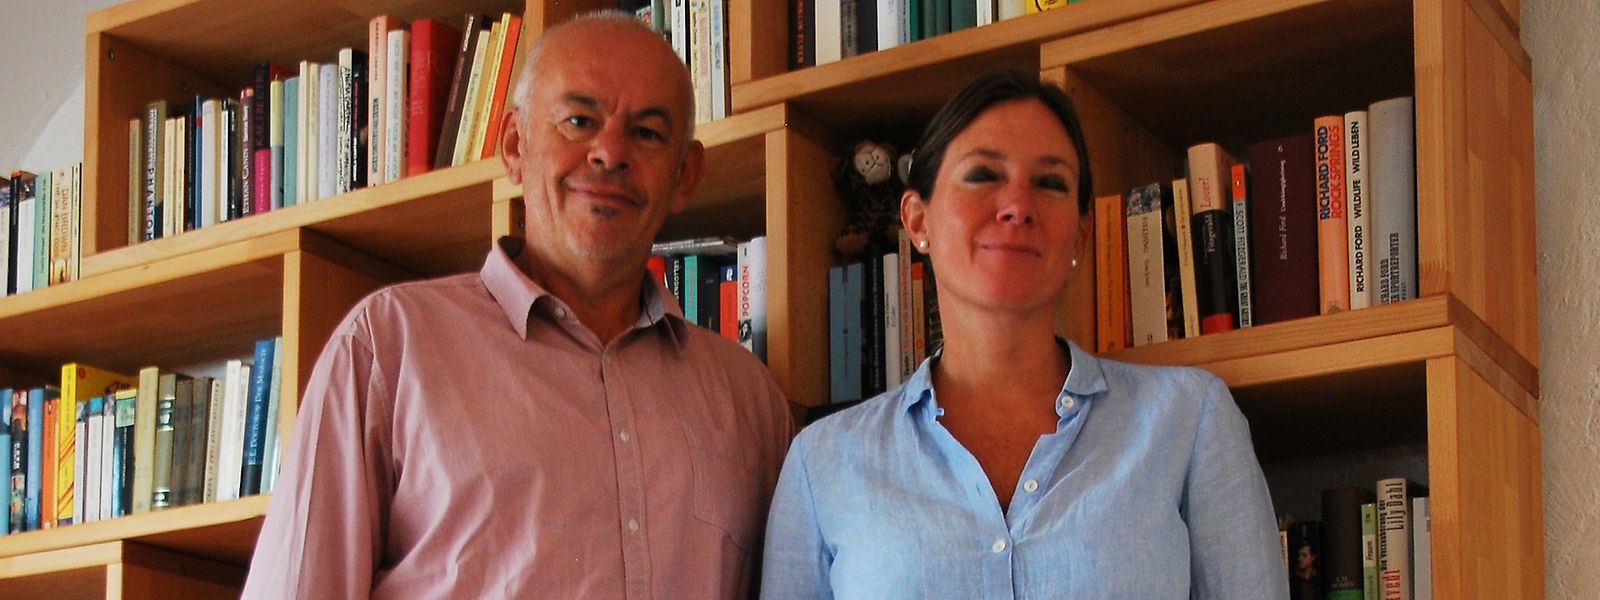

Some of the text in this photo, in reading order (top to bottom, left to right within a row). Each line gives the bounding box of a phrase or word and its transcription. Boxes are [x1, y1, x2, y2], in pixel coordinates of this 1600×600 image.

[1198, 177, 1211, 208] Lover!
[1317, 126, 1331, 220] RICHARD FORD
[1328, 125, 1343, 219] ROCK SPRINGS
[146, 167, 155, 241] PHANTOM
[242, 180, 250, 214] ETHAN
[1350, 121, 1365, 292] RICHARD FORD WILDLIFE WILD LEBEN
[60, 213, 69, 252] BROWN
[1142, 216, 1150, 254] FIELDING
[1204, 214, 1216, 253] Fitzgerald
[1236, 211, 1245, 233] SCOTT
[1278, 216, 1287, 232] Ford
[1236, 237, 1247, 280] FITZGERALD
[1279, 234, 1288, 260] Richard
[1389, 233, 1399, 293] SPORTREPORTER
[742, 266, 750, 317] POPCORN
[1380, 259, 1389, 304] CHARD FORD
[250, 405, 261, 448] DOCTOROW
[1378, 500, 1386, 510] der
[1385, 483, 1406, 531] Lily Dahl
[1379, 513, 1387, 559] Verzauberung
